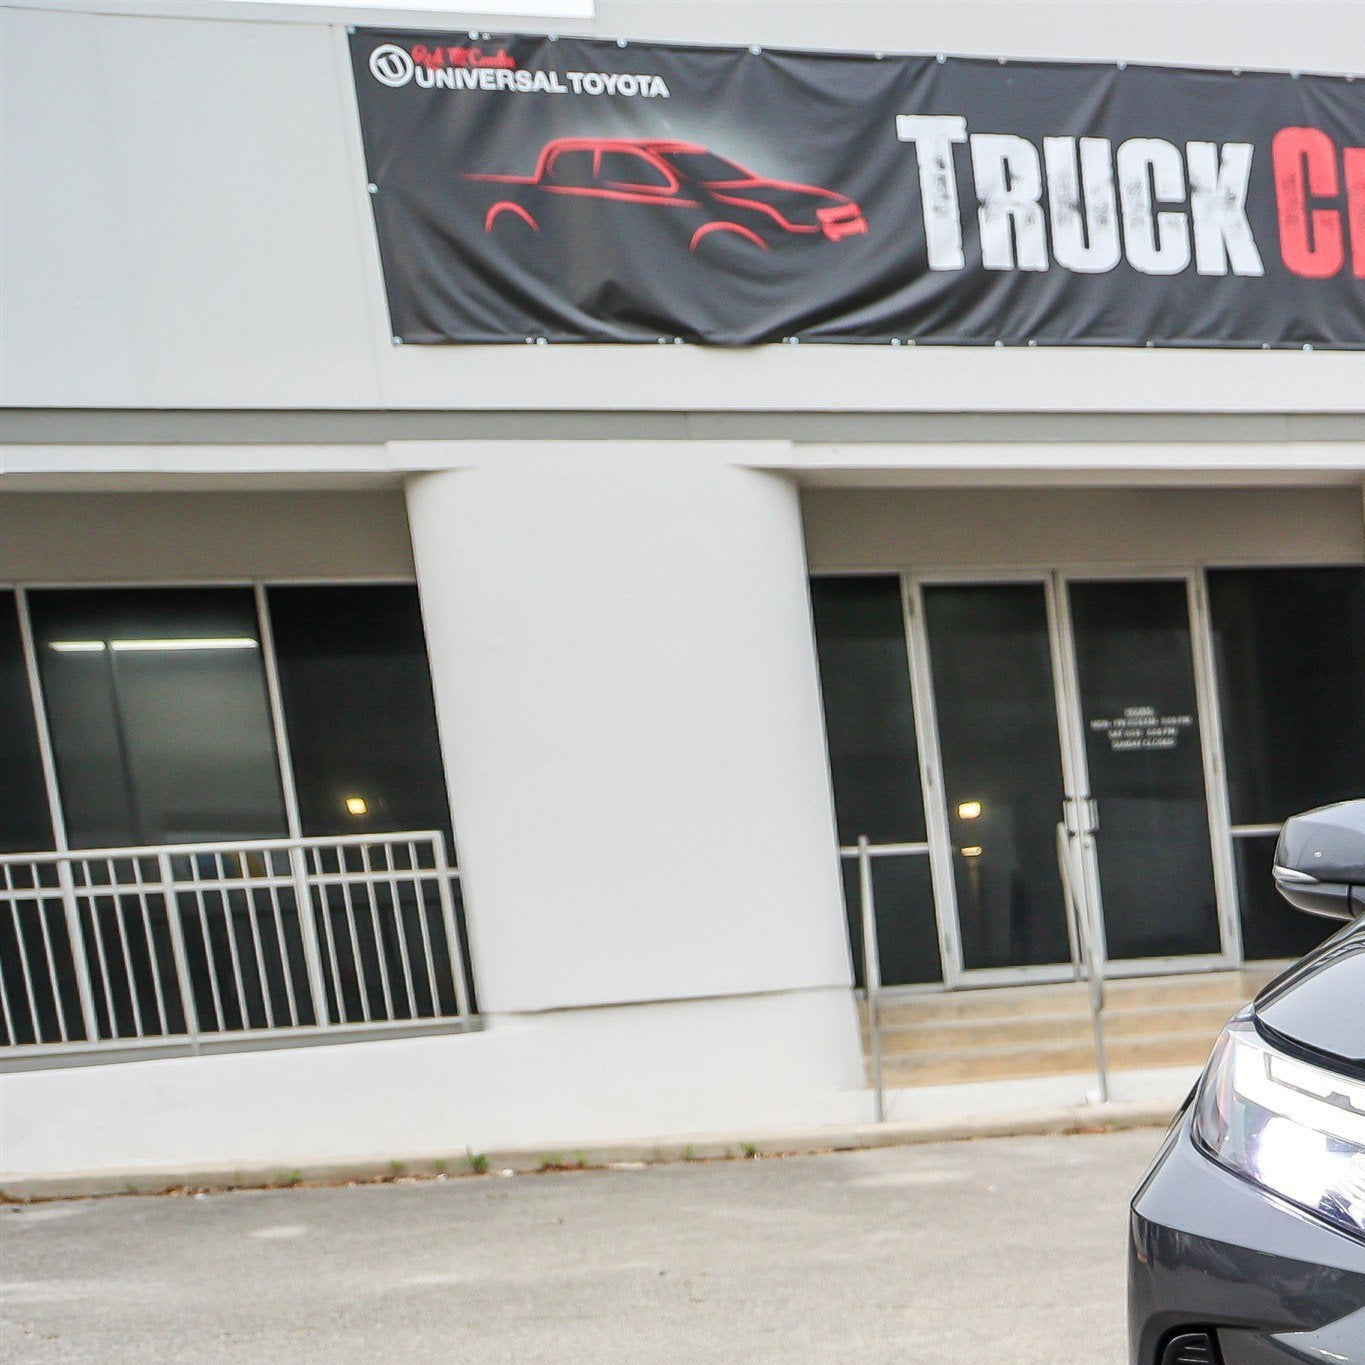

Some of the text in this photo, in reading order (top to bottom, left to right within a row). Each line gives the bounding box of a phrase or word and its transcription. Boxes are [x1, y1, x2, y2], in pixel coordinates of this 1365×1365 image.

[414, 65, 670, 98] UNIVERSAL TOYOTA
[896, 114, 1264, 278] TRUCK
